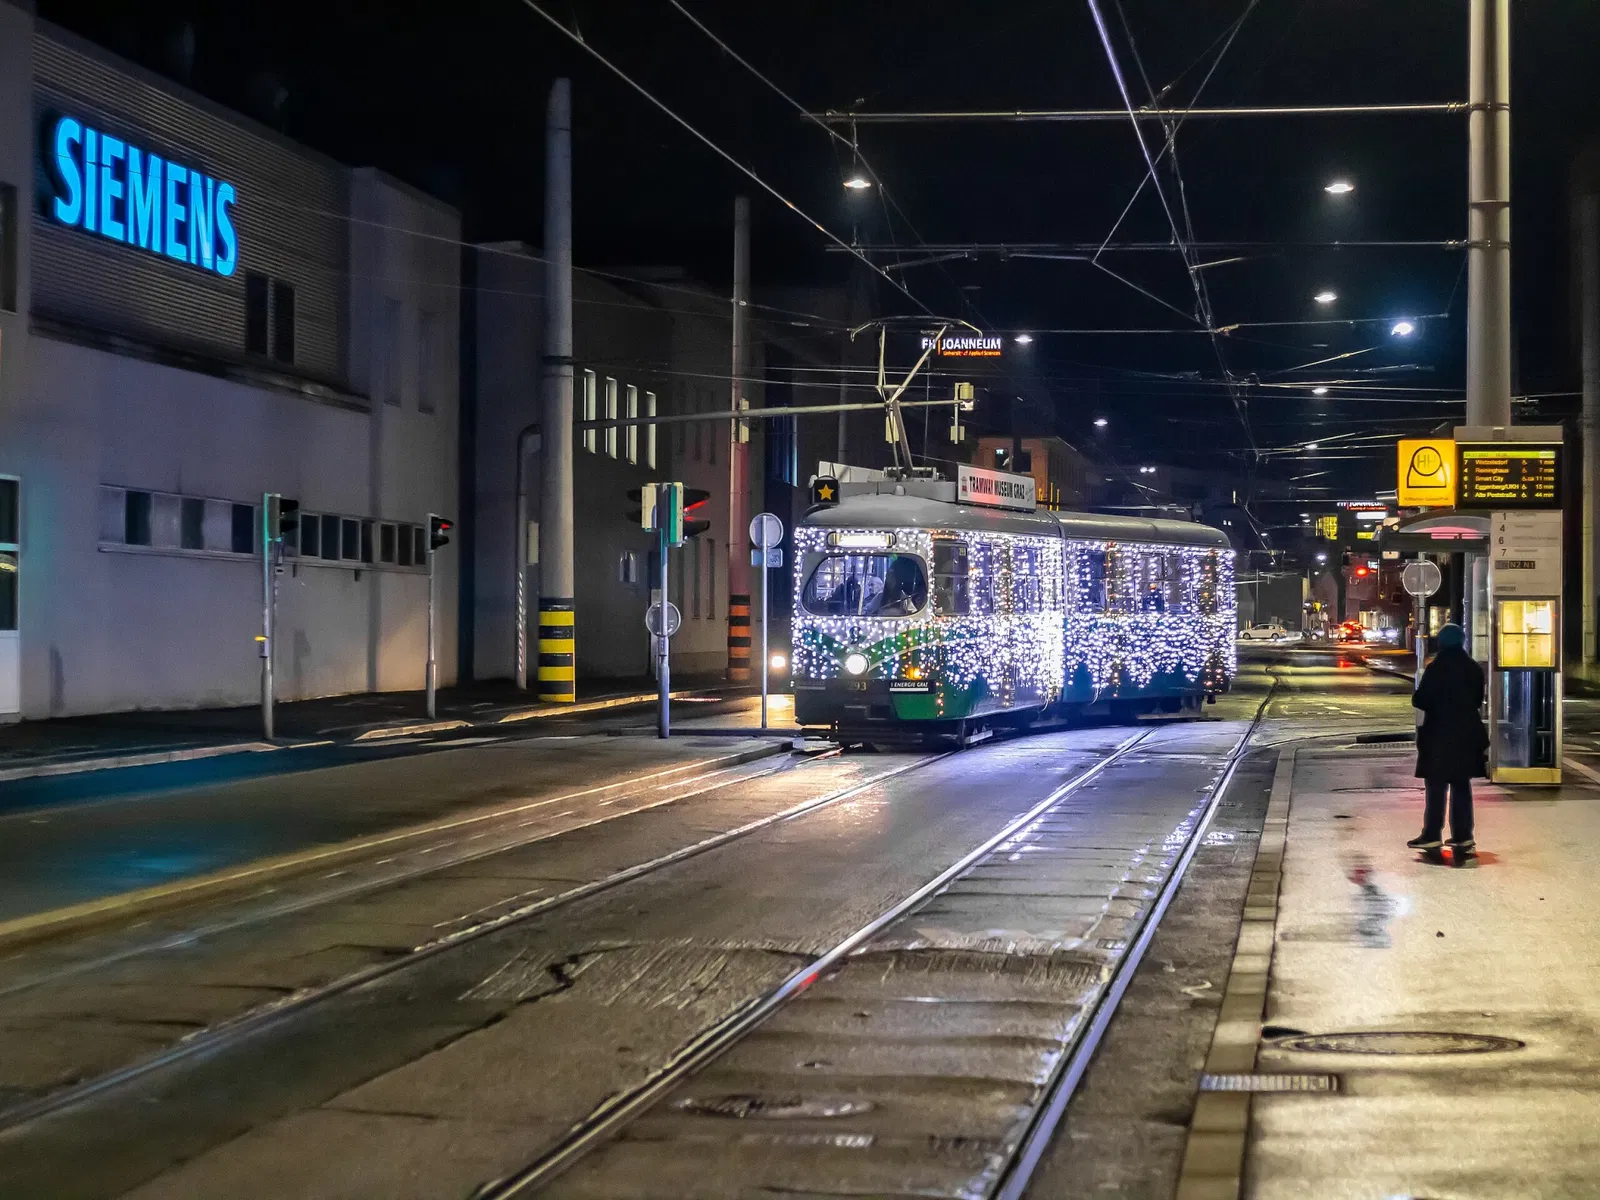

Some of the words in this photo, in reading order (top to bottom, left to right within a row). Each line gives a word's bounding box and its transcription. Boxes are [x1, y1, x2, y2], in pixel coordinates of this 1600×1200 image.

[54, 117, 238, 276] SIEMENS
[922, 338, 936, 350] FH
[942, 338, 1001, 350] JOANNEUM
[969, 476, 993, 495] TRAMWAY
[994, 480, 1013, 498] MUSEUM
[1013, 483, 1025, 499] GRAZ
[1502, 512, 1507, 520] 1
[1500, 524, 1505, 532] 4
[1498, 536, 1504, 544] 6
[1501, 548, 1507, 556] 7
